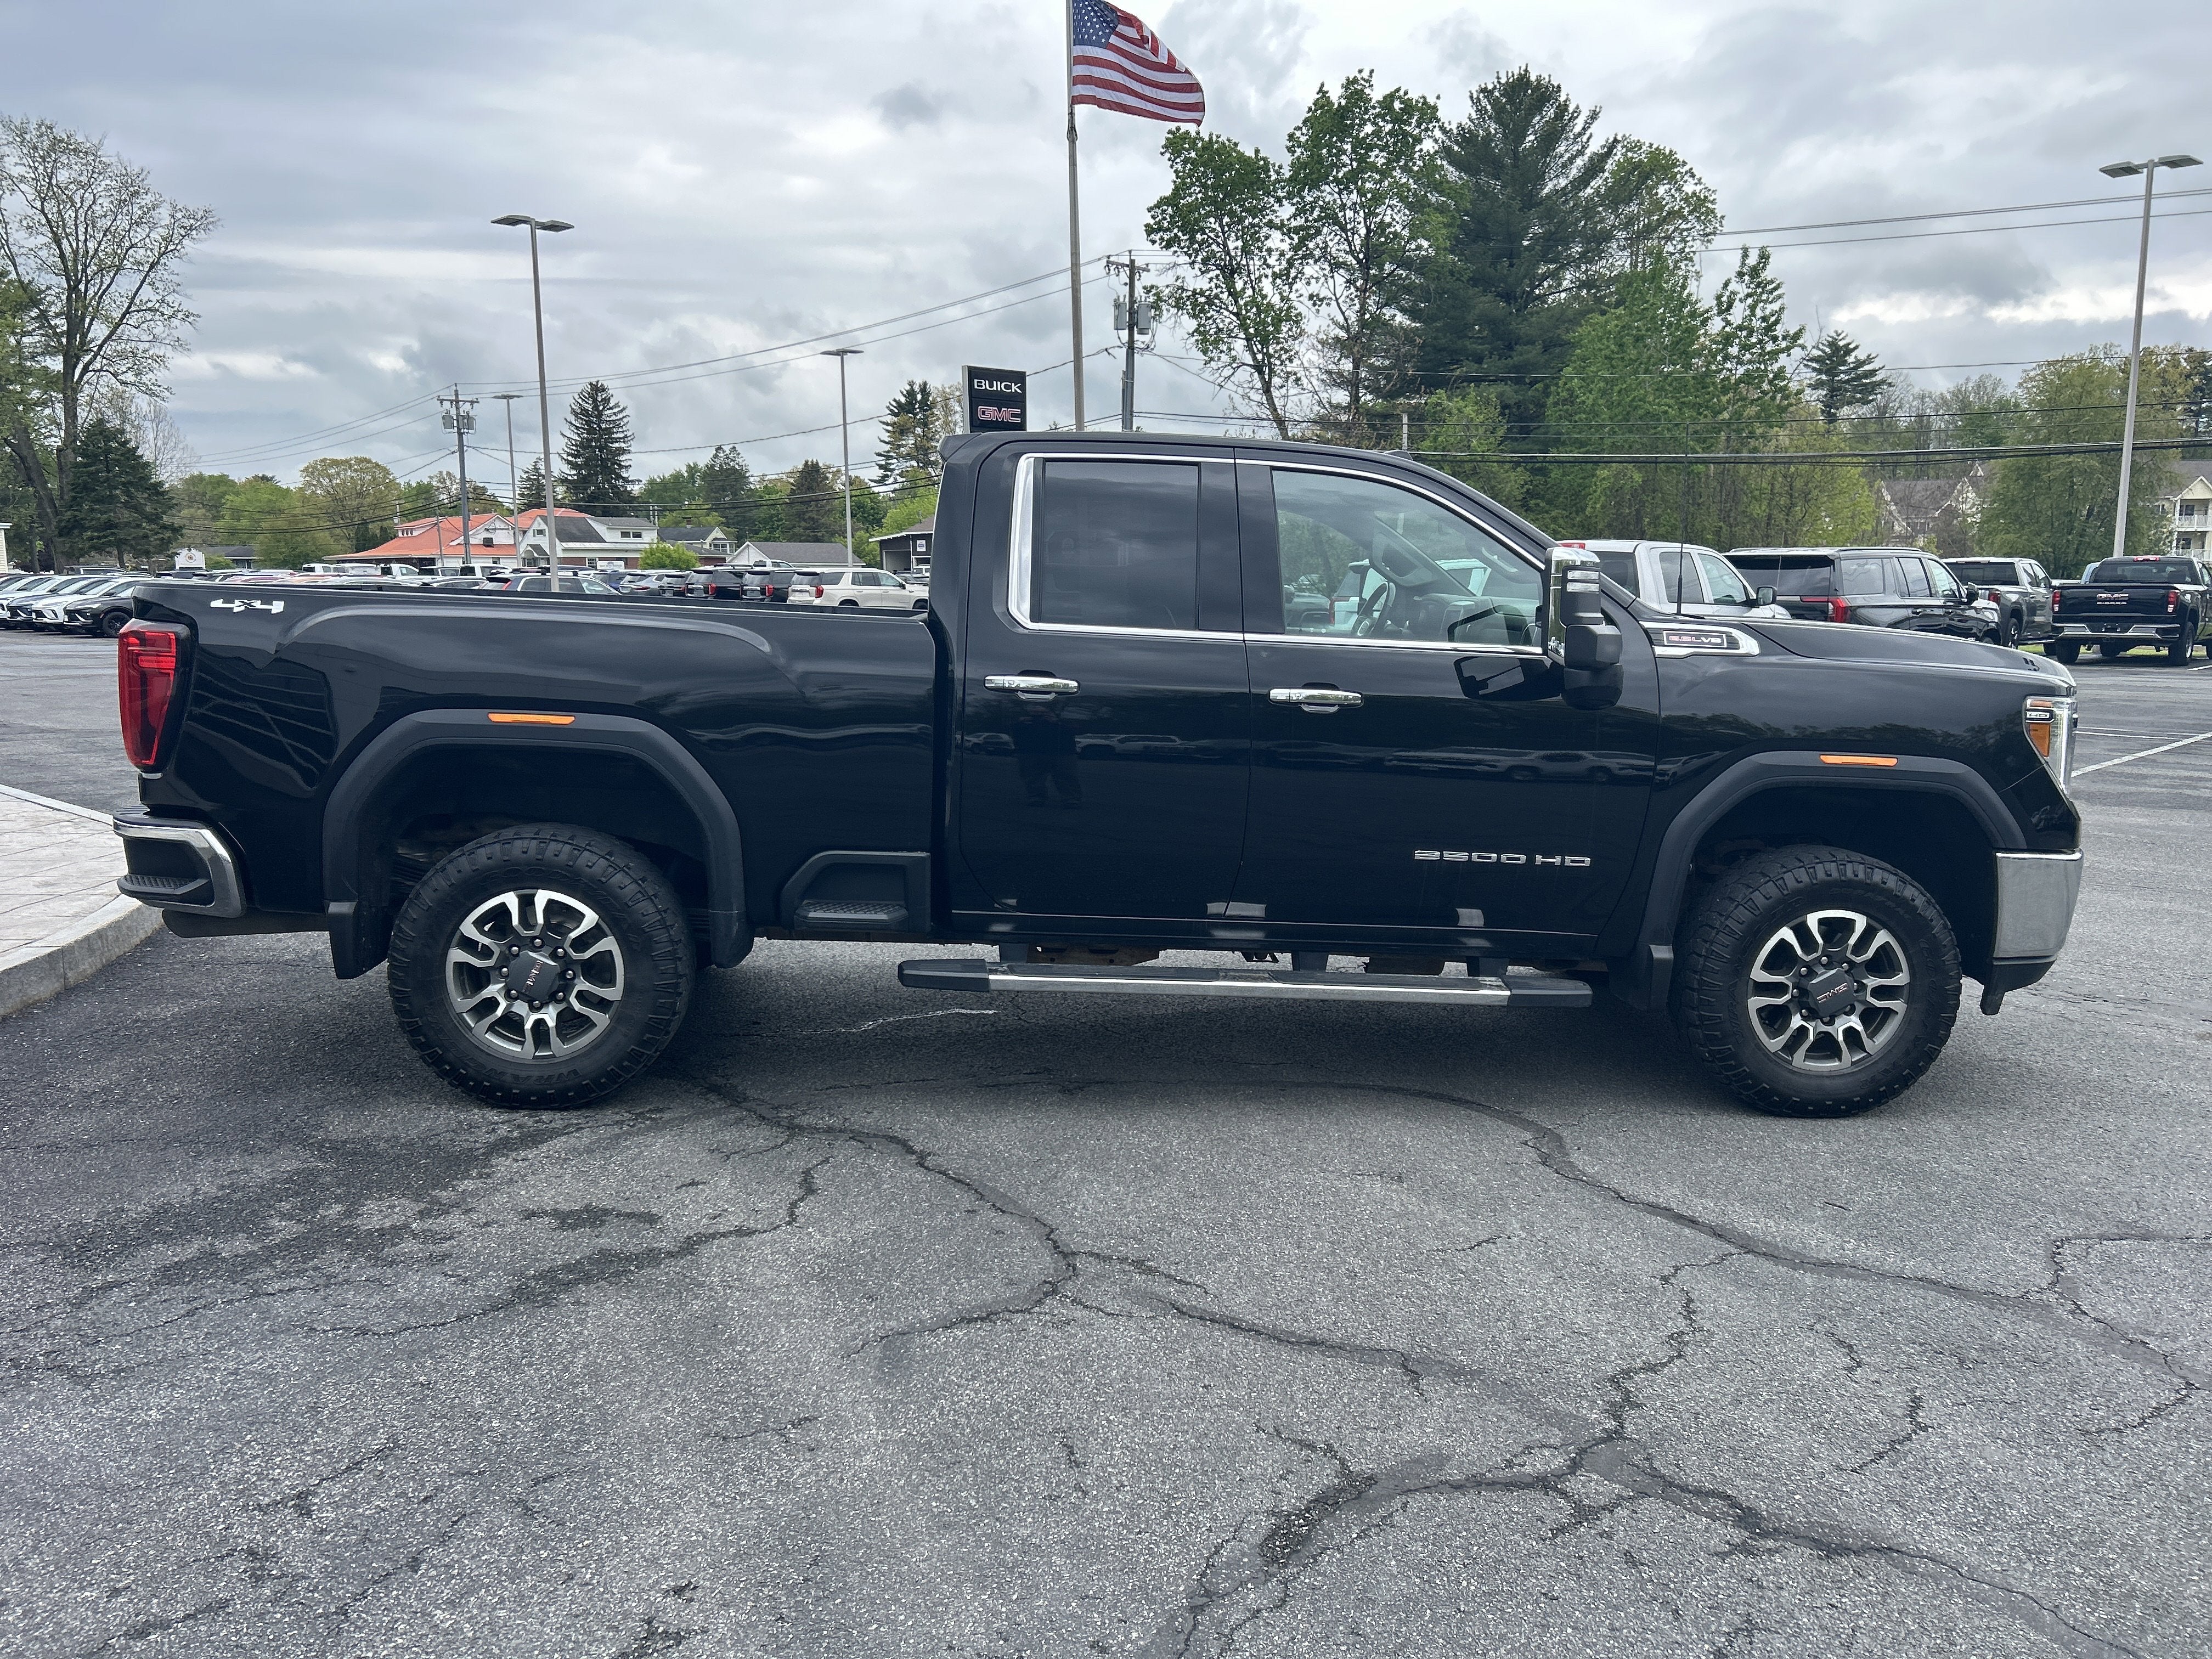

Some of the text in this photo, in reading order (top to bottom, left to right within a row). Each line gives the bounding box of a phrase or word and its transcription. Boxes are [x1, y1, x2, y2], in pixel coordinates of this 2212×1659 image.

[974, 379, 1022, 393] BUICK
[978, 405, 1021, 423] GMC
[1414, 850, 1591, 867] 2500 HD
[1816, 983, 1848, 1003] GMC
